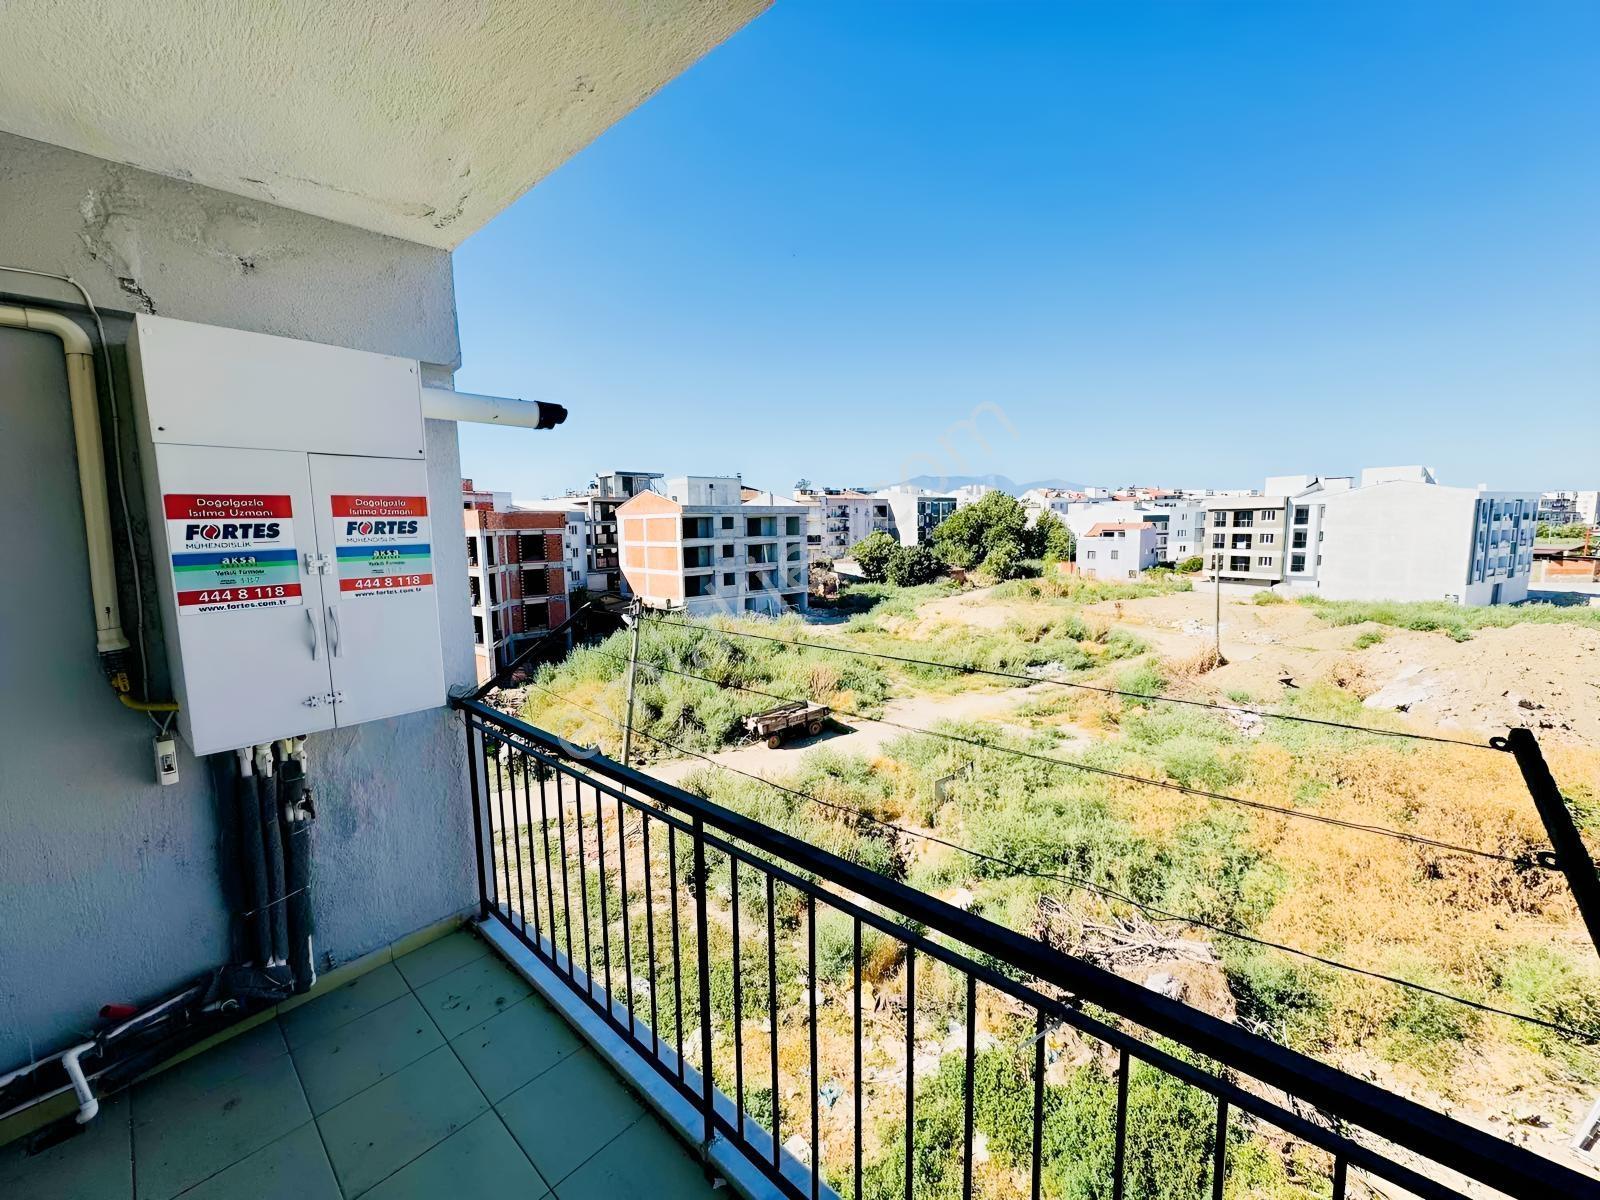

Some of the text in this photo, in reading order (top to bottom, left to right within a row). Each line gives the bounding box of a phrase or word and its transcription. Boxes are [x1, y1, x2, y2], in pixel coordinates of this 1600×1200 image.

[196, 498, 264, 507] Doğalgazla
[229, 508, 273, 517] Uzmanı
[185, 522, 280, 540] FORTES
[346, 520, 418, 535] FORTES
[221, 555, 256, 564] aksa
[355, 575, 421, 589] 444 8 118
[198, 586, 285, 602] 444 8 118
[198, 599, 287, 612] www.fortes.com.tr
